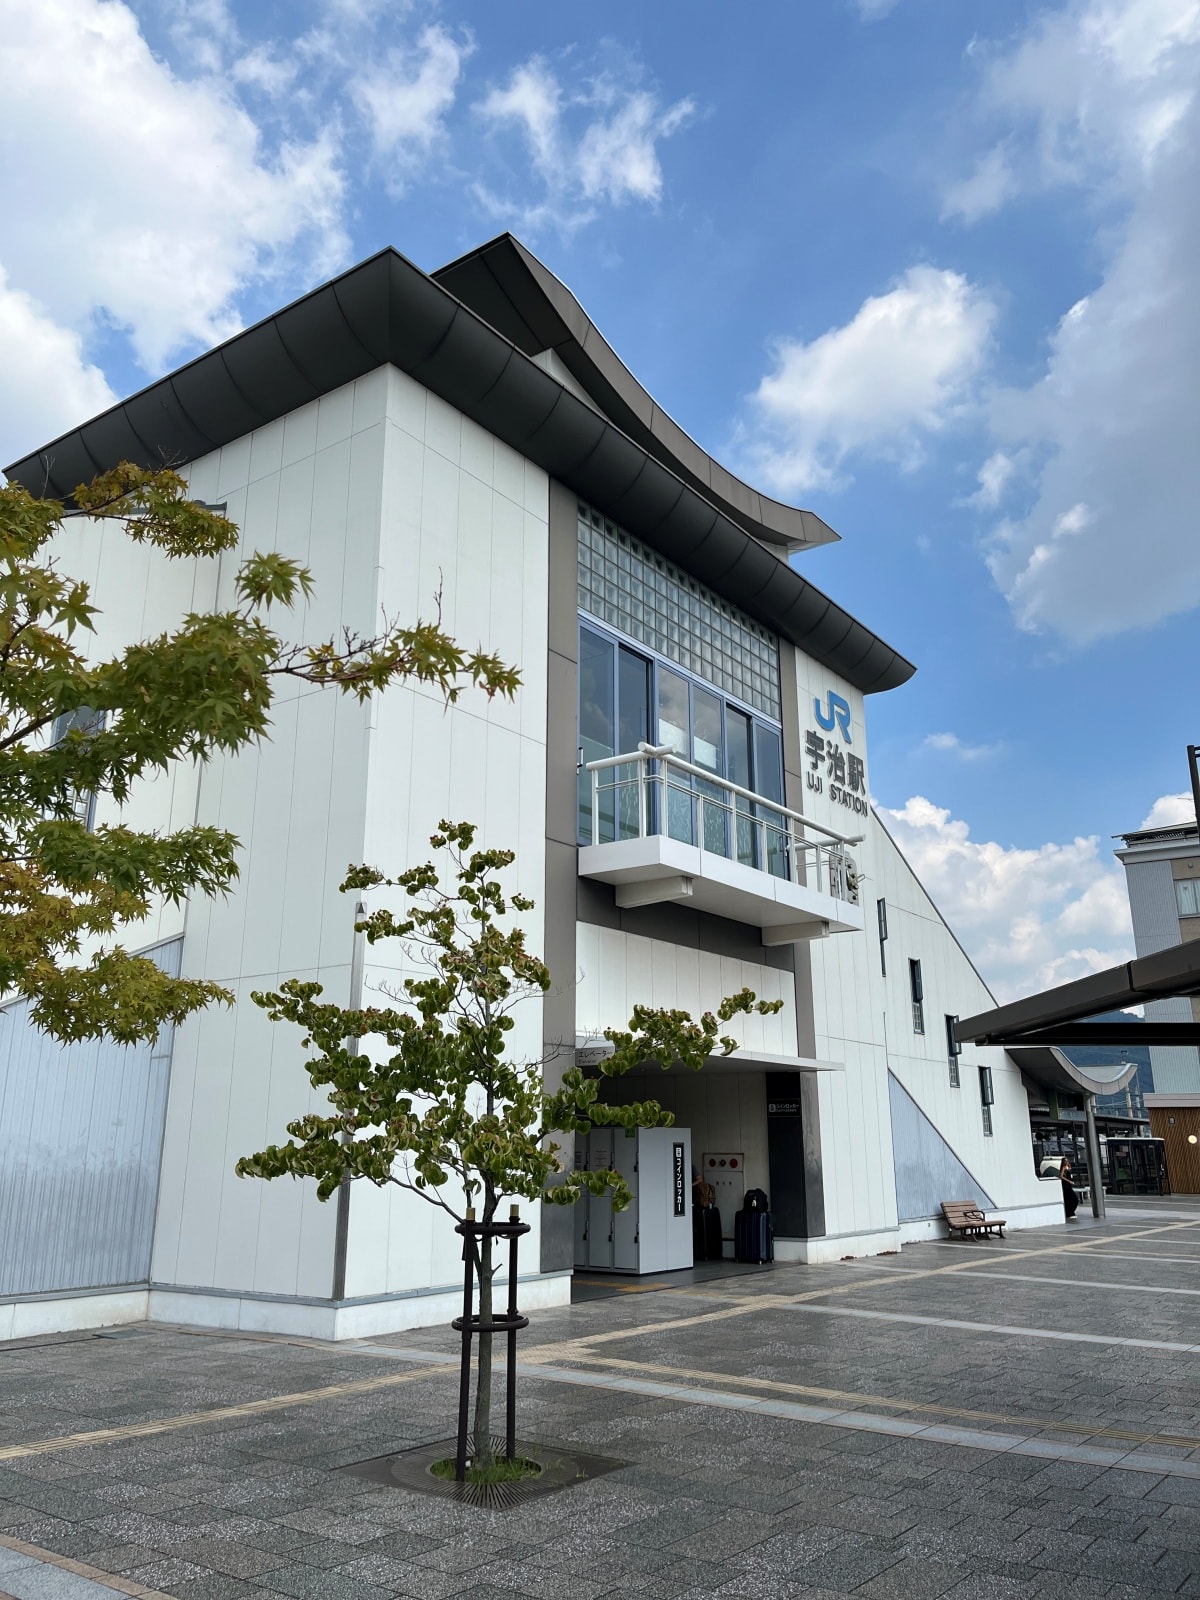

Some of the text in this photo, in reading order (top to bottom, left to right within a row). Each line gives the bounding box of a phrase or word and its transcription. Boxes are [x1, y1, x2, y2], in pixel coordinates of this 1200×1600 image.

[814, 690, 852, 744] JR
[805, 730, 866, 796] 宇治駅
[806, 771, 868, 817] UJI STATION
